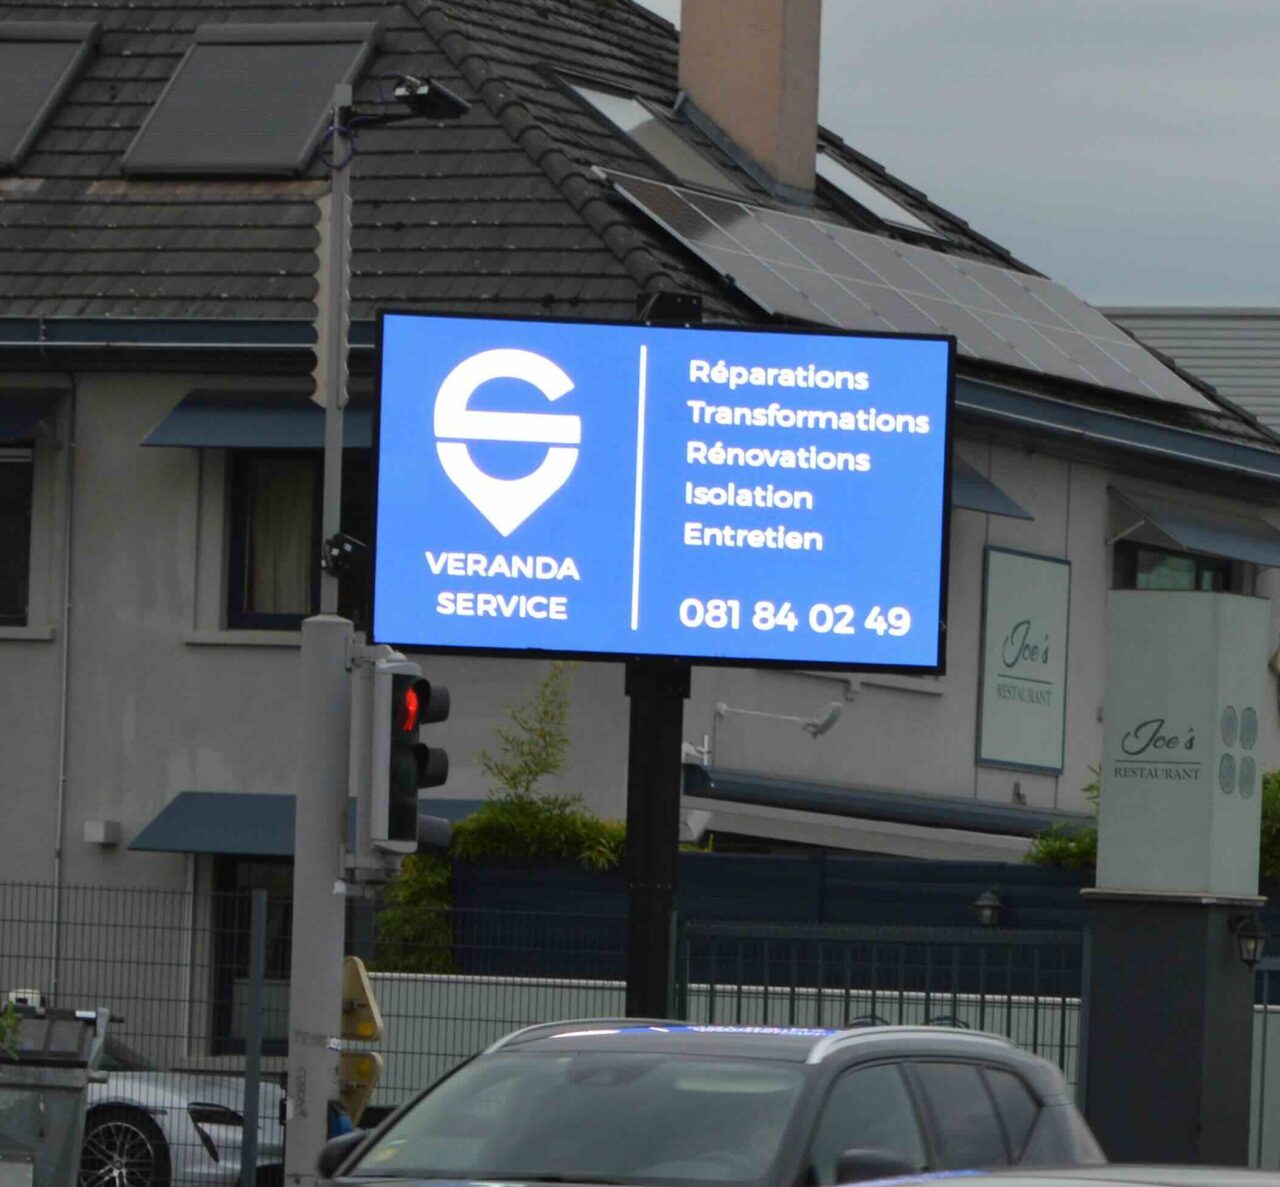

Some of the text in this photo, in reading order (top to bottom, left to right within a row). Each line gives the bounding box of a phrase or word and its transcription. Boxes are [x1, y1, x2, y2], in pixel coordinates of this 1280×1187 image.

[688, 359, 870, 391] Réparations
[686, 399, 930, 434] Transformations
[686, 440, 871, 472] Rénovations
[685, 481, 814, 510] Isolation
[683, 521, 824, 551] Entretien
[425, 551, 581, 581] VERANDA
[436, 591, 568, 620] SERVICE
[679, 597, 912, 637] 081 84 02 49
[1001, 619, 1050, 668] Joe's
[996, 683, 1053, 706] RESTAURANT
[1120, 718, 1196, 756] Joe's
[1113, 766, 1200, 781] RESTAURANT
